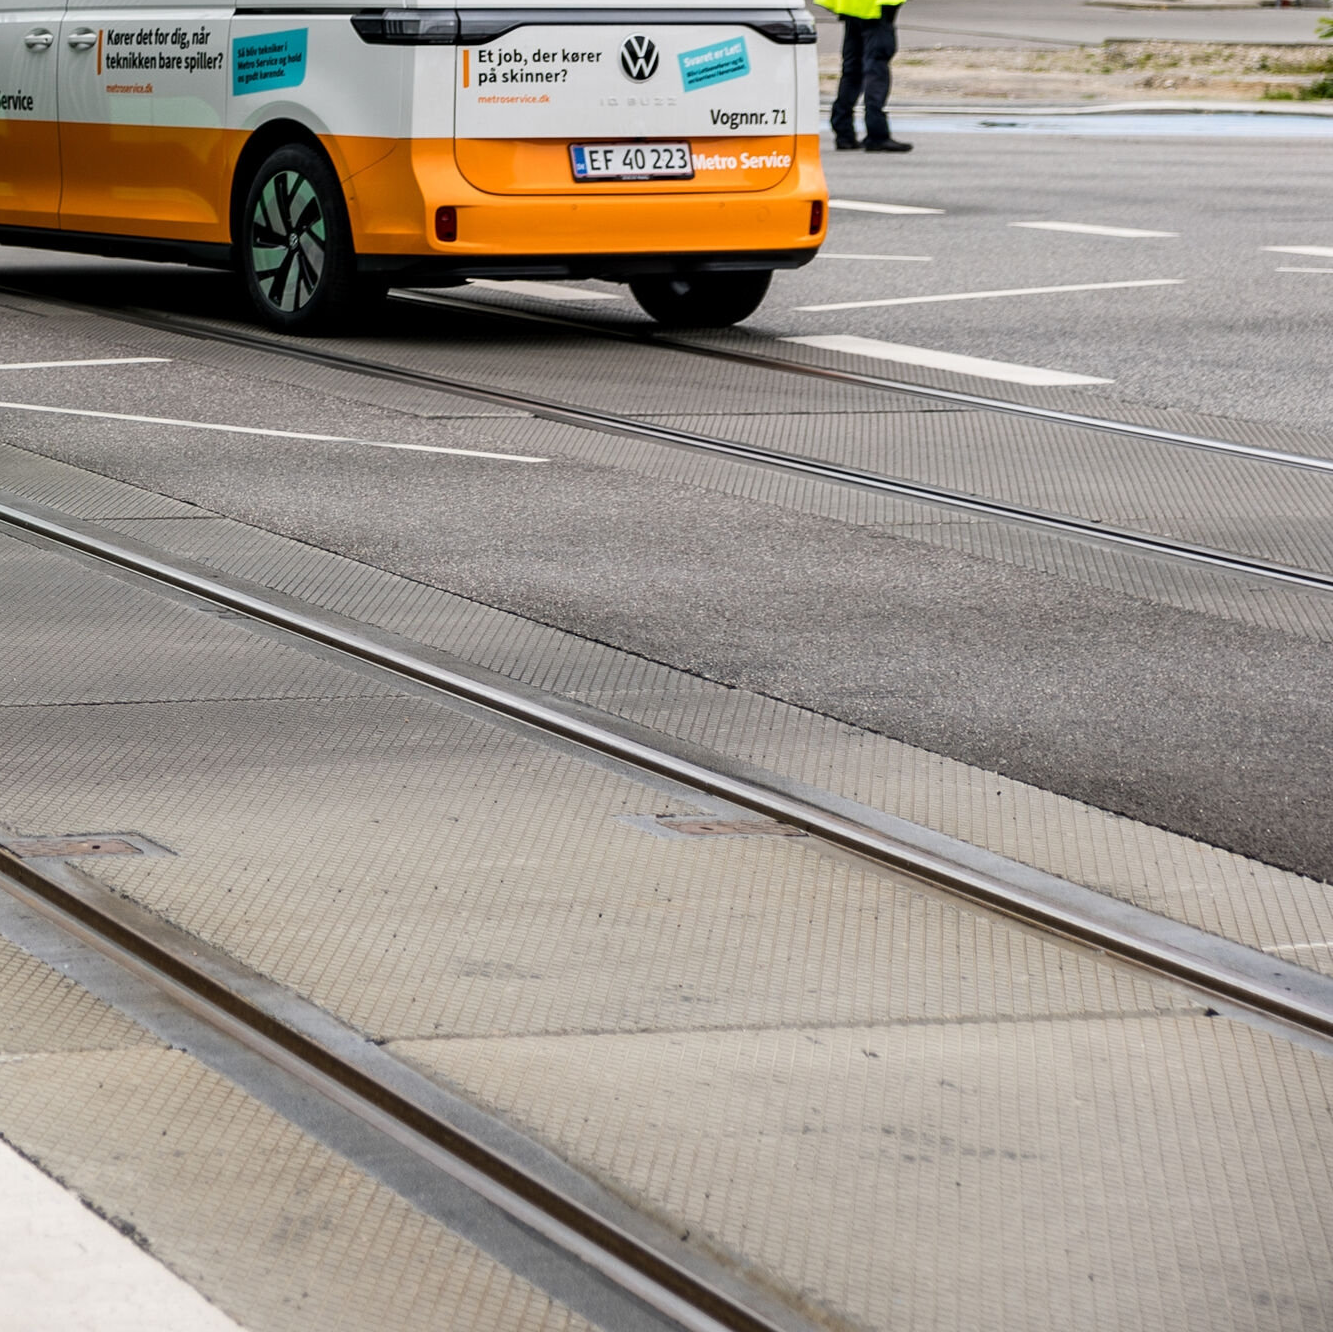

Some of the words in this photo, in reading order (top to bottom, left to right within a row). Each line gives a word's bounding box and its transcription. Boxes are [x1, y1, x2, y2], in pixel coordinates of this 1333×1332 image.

[107, 28, 135, 47] Kører
[136, 28, 153, 46] det
[155, 27, 169, 45] for
[170, 26, 190, 49] dig,
[192, 26, 210, 45] når
[106, 51, 157, 70] teknikken
[158, 51, 182, 69] bare
[183, 51, 223, 73] spiller?
[256, 56, 278, 68] Service
[478, 49, 494, 63] Et
[496, 48, 528, 67] job,
[532, 48, 558, 63] der
[561, 48, 602, 63] kører
[478, 67, 498, 86] på
[501, 69, 568, 84] skinner?
[106, 82, 153, 94] metroservice.dk
[478, 94, 550, 104] metroservice.dk
[710, 108, 768, 130] Vognnr.
[772, 108, 788, 125] 71
[589, 149, 614, 171] EF
[622, 148, 646, 170] 40
[650, 148, 688, 170] 223
[692, 153, 737, 171] Metro
[740, 150, 791, 170] Service
